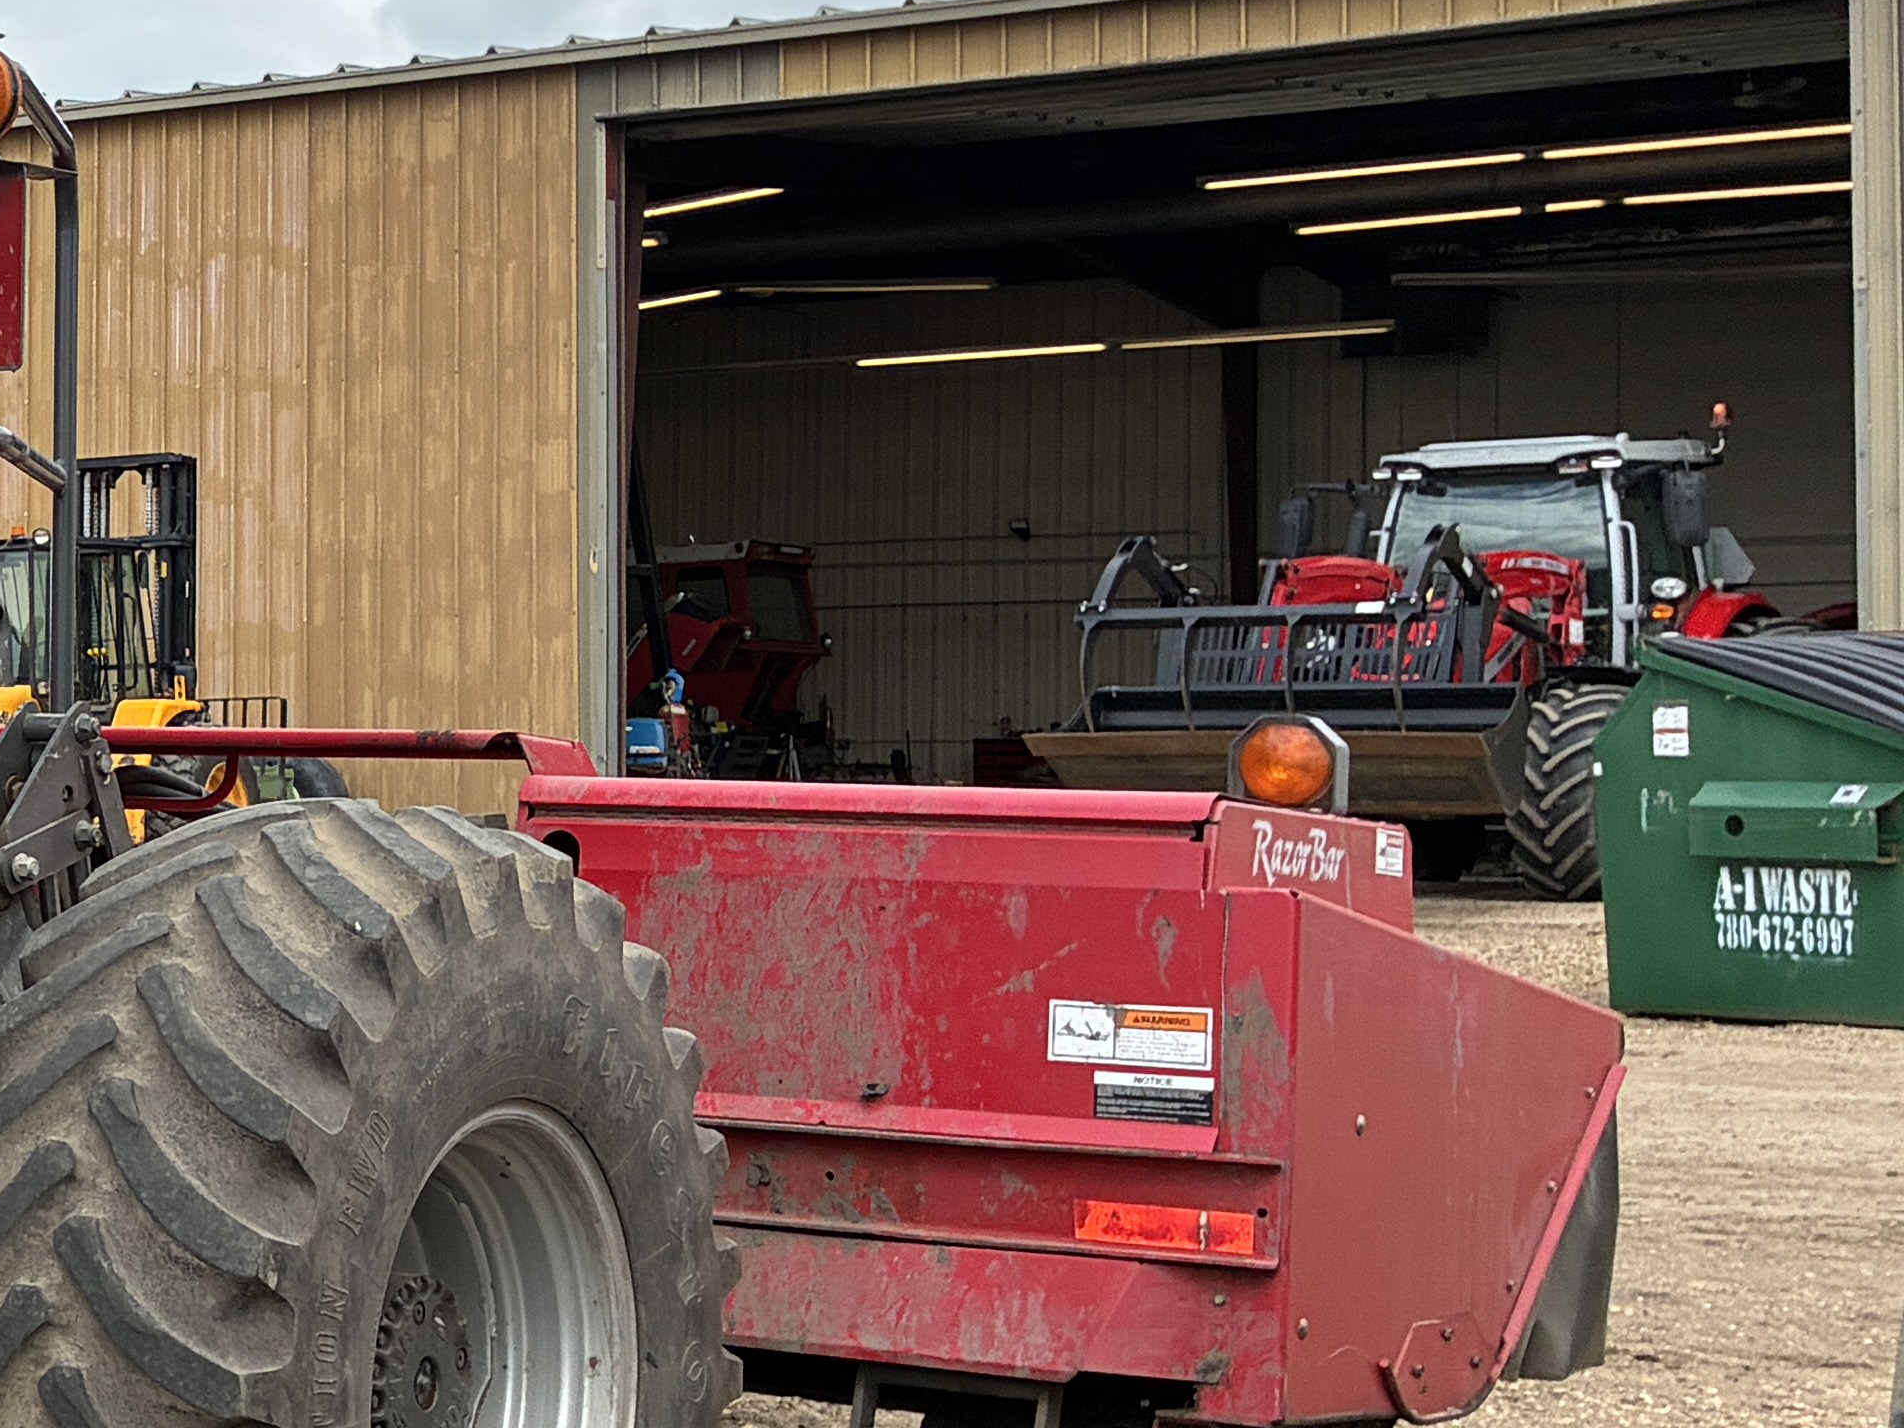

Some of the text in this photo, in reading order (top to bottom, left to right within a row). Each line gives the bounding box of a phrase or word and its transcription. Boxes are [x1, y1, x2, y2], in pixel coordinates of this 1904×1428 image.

[1713, 866, 1853, 917] A-1 WASTE
[1715, 913, 1855, 956] 780-672-6997
[1141, 1015, 1191, 1026] WARNING
[1133, 1076, 1174, 1086] NOTICE
